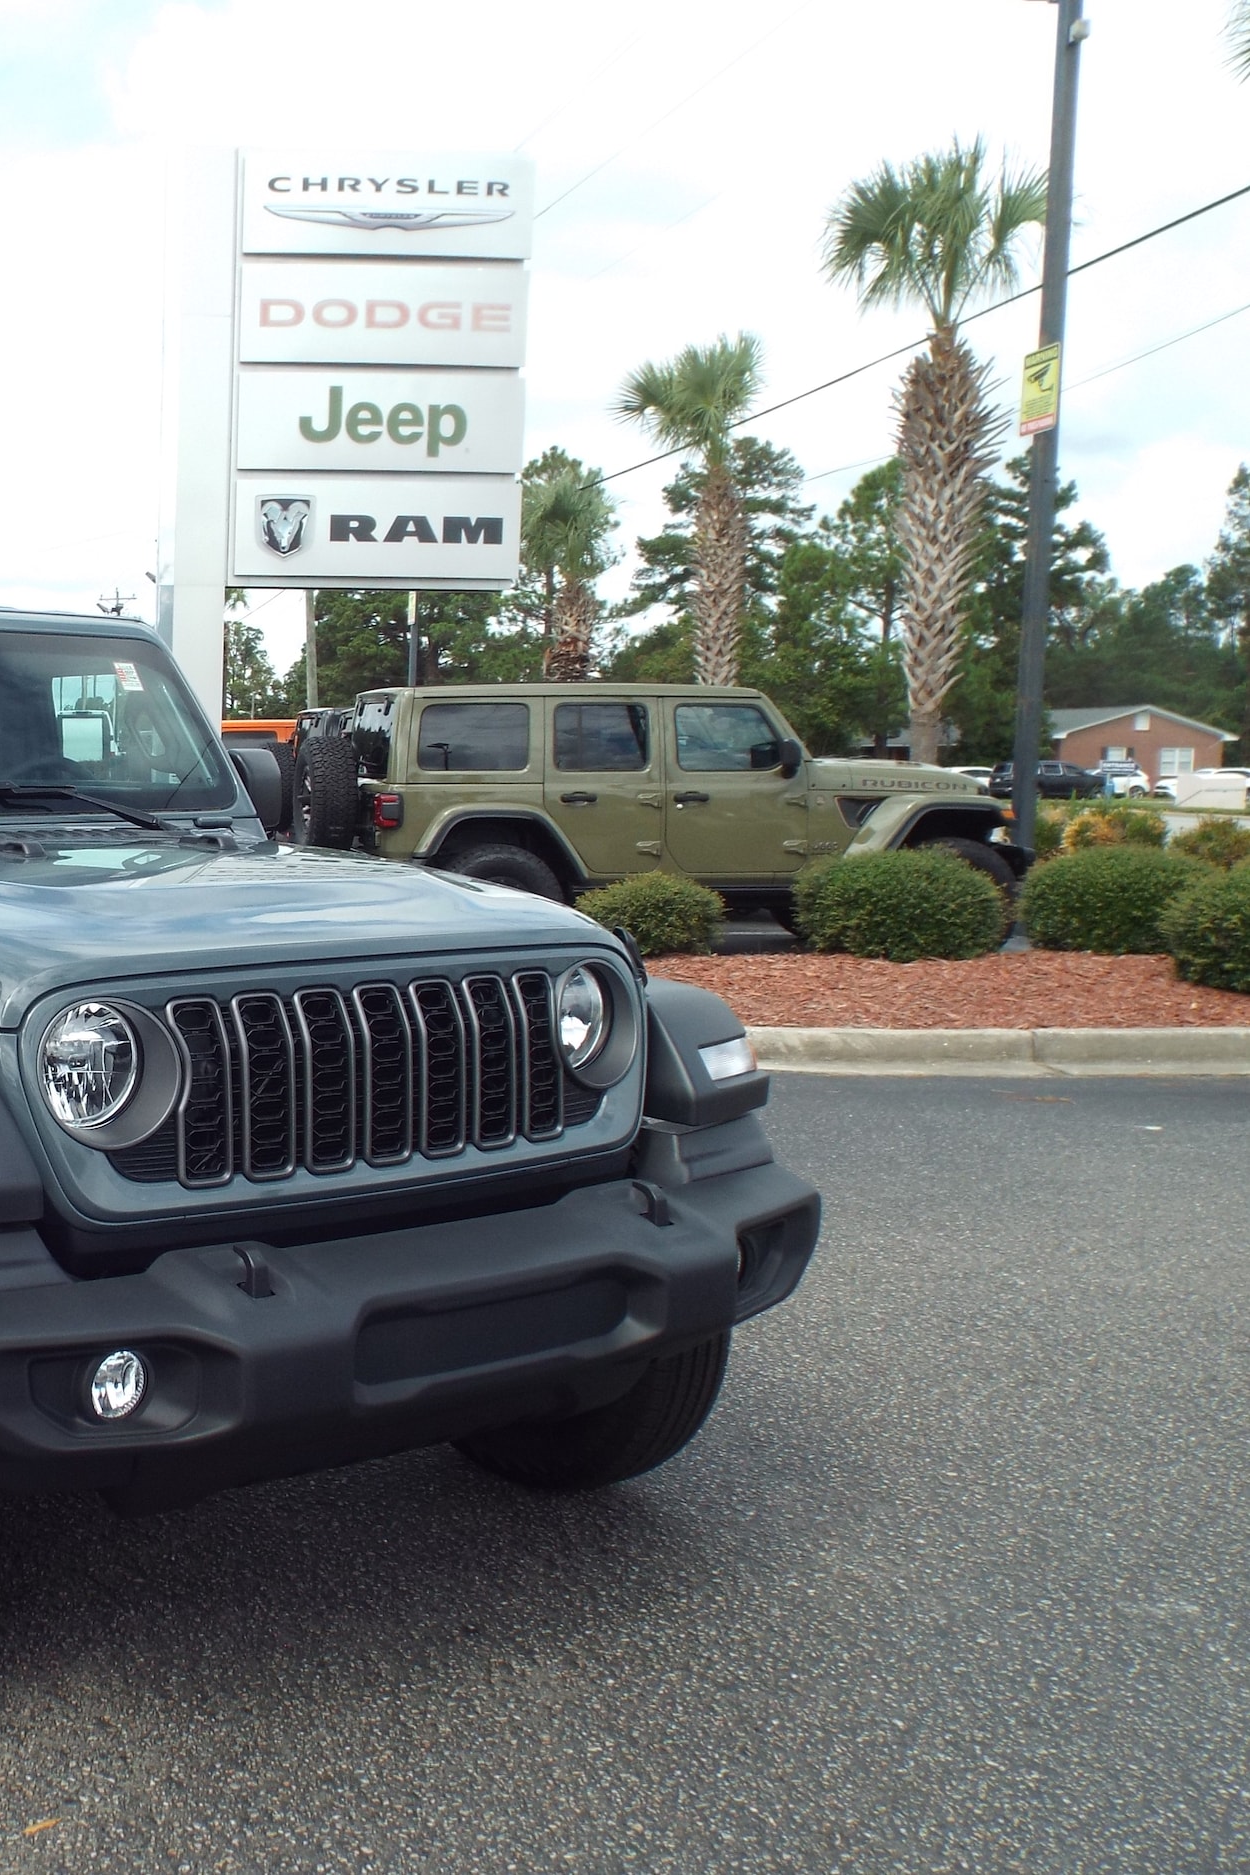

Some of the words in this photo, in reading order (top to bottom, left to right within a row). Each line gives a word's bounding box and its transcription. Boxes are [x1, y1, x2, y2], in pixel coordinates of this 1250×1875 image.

[268, 176, 510, 198] CHRYSLER
[259, 298, 512, 332] DODGE
[299, 386, 467, 457] Jeep
[329, 514, 503, 545] RAM
[861, 778, 968, 791] RUBICON
